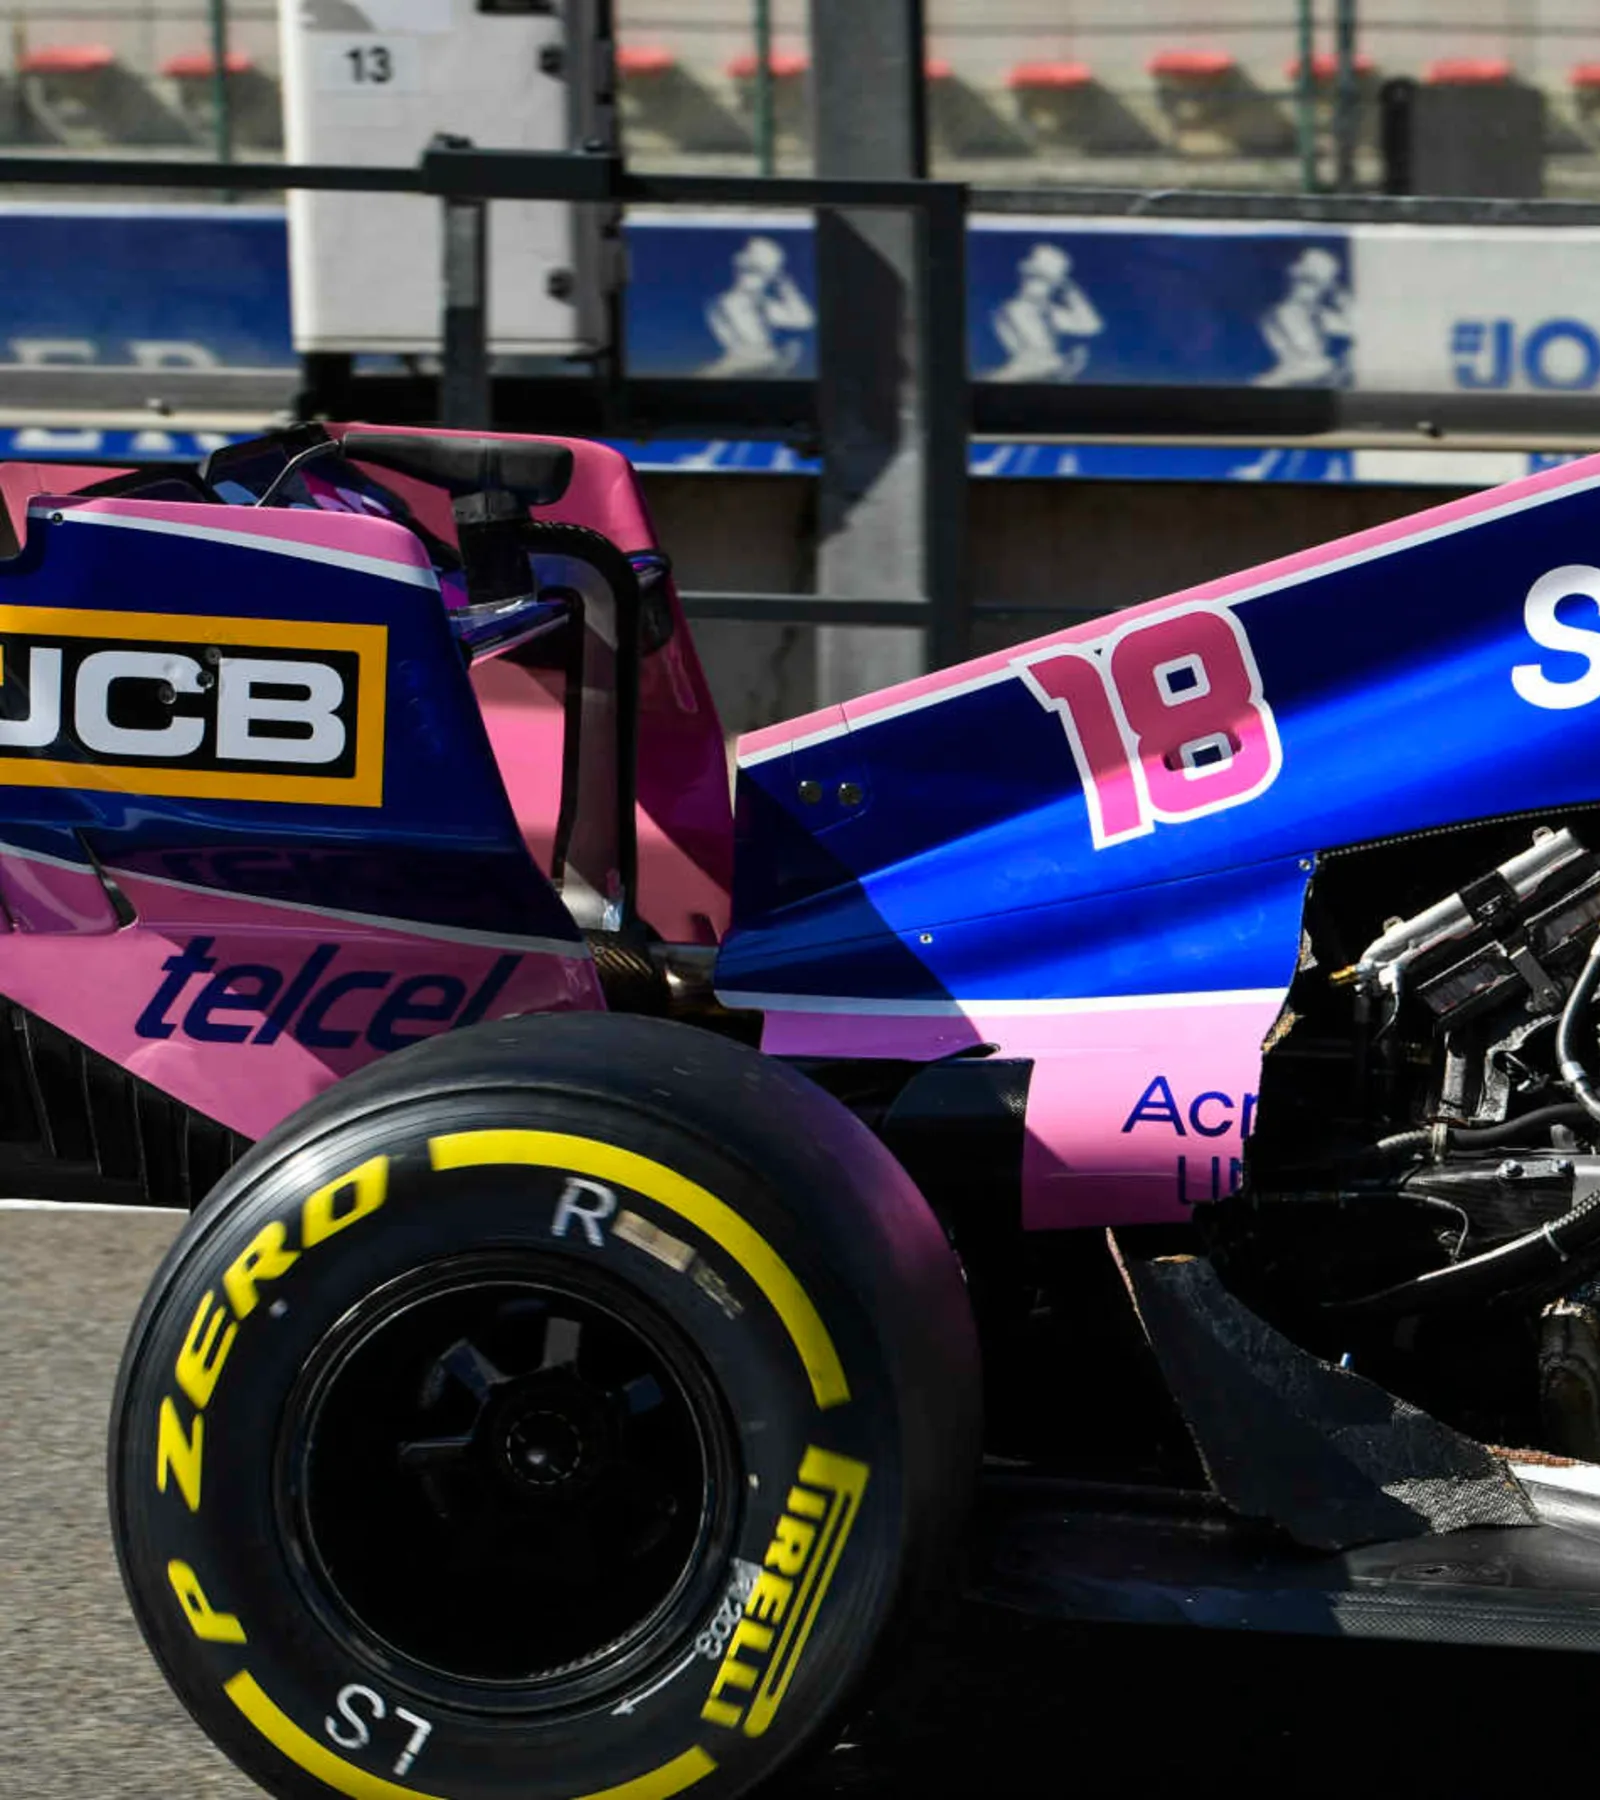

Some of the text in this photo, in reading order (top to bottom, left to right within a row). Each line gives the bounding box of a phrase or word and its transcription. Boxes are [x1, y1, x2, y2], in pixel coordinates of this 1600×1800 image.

[343, 46, 394, 85] 13
[0, 646, 346, 764] JCB
[1007, 600, 1283, 850] 18
[139, 935, 525, 1053] telcel
[552, 1176, 617, 1248] R
[156, 1155, 388, 1513] ZERO
[701, 1444, 870, 1738] PIRELLI
